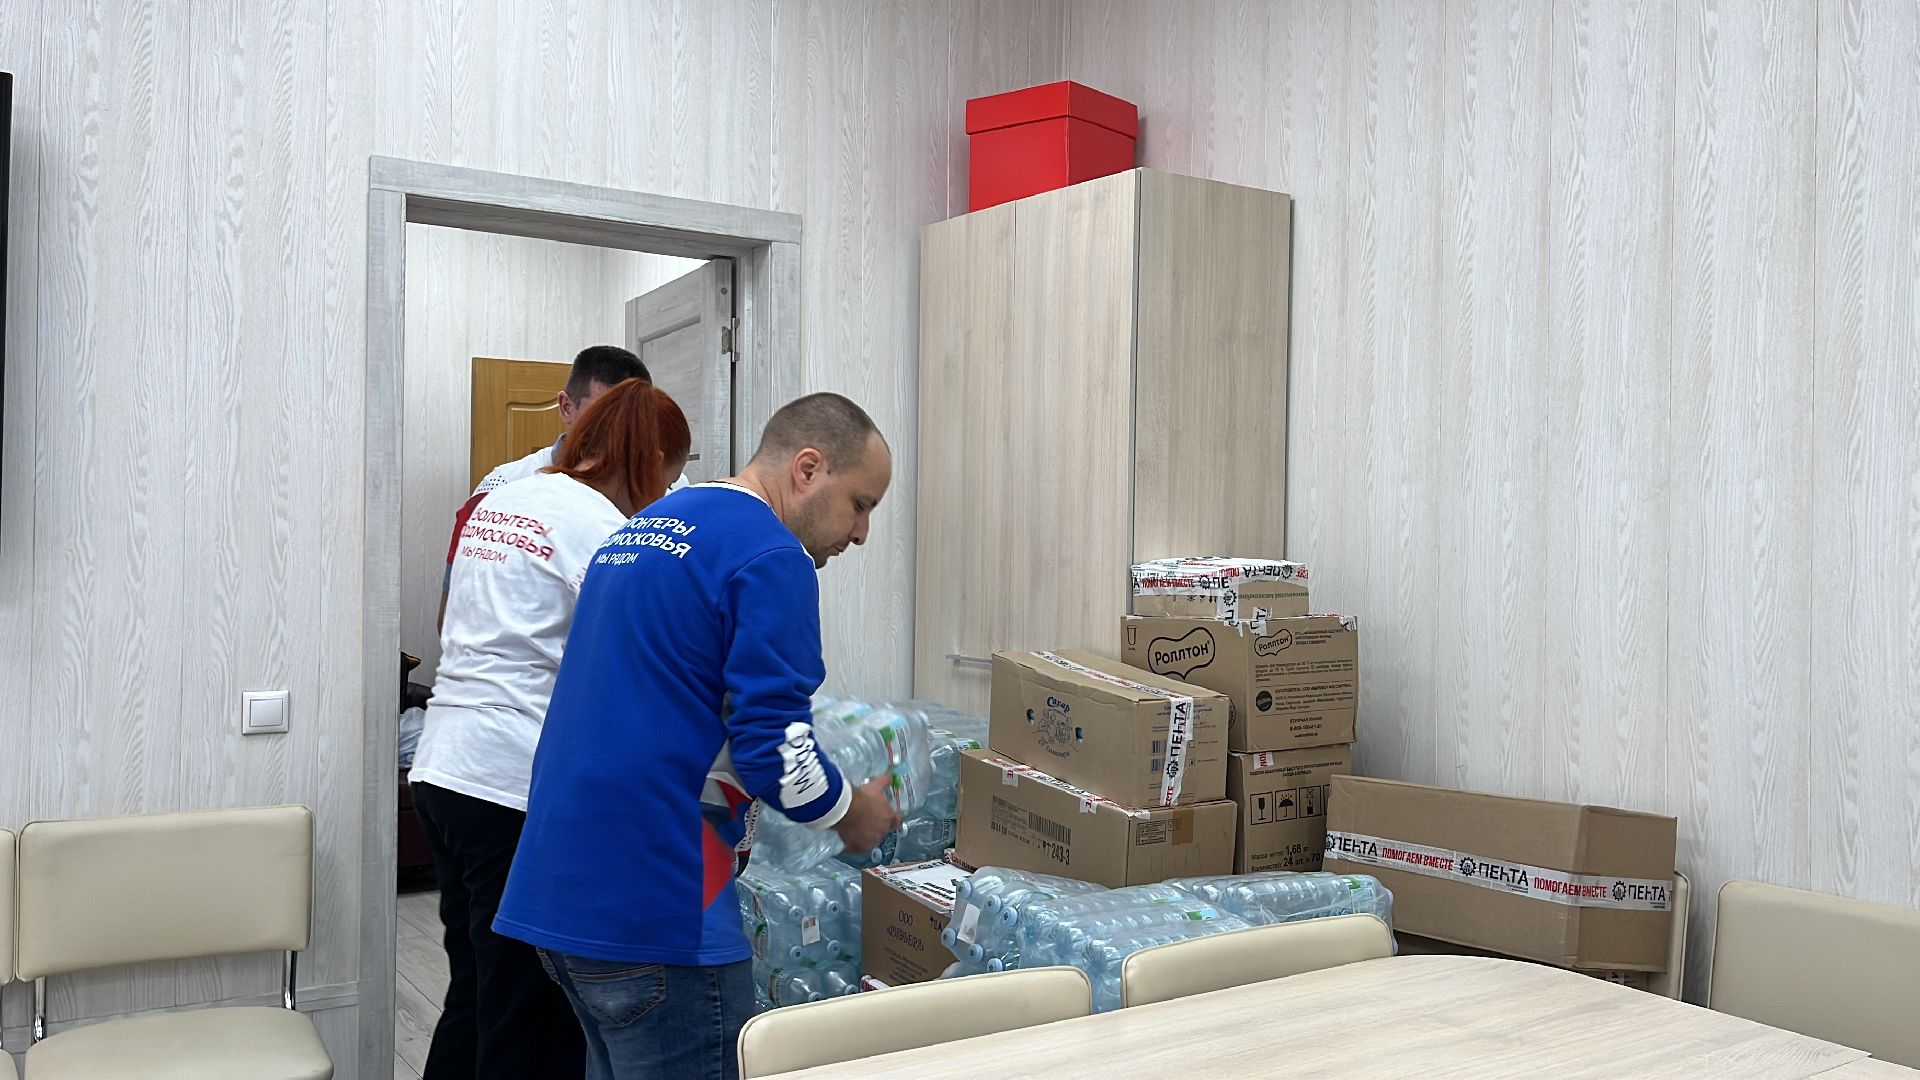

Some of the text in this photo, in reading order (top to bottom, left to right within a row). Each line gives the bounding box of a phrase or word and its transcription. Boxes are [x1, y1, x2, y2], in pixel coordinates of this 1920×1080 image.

[625, 515, 696, 536] ЛОНТЕРЫ
[461, 524, 554, 561] ДМОСКОВЬЯ
[474, 547, 507, 564] РЯДОМ
[608, 552, 639, 566] РЯДОМ
[1243, 565, 1281, 577] ПЕНТА
[1259, 636, 1289, 651] Роллтон
[1155, 643, 1208, 666] Роллтон
[1047, 697, 1070, 714] Сахар
[1170, 701, 1186, 756] ПЕНТА
[1284, 857, 1293, 867] 24
[1311, 853, 1320, 862] 70
[1382, 847, 1422, 865] ПОМОГАЕМ
[1423, 855, 1454, 871] ВМЕСТЕ
[1478, 863, 1529, 886] ПЕНТА
[1534, 877, 1581, 896] ПОМОГАЕМ
[1582, 886, 1607, 898] ВМЕСТЕ
[1629, 885, 1665, 901] ПЕНТА
